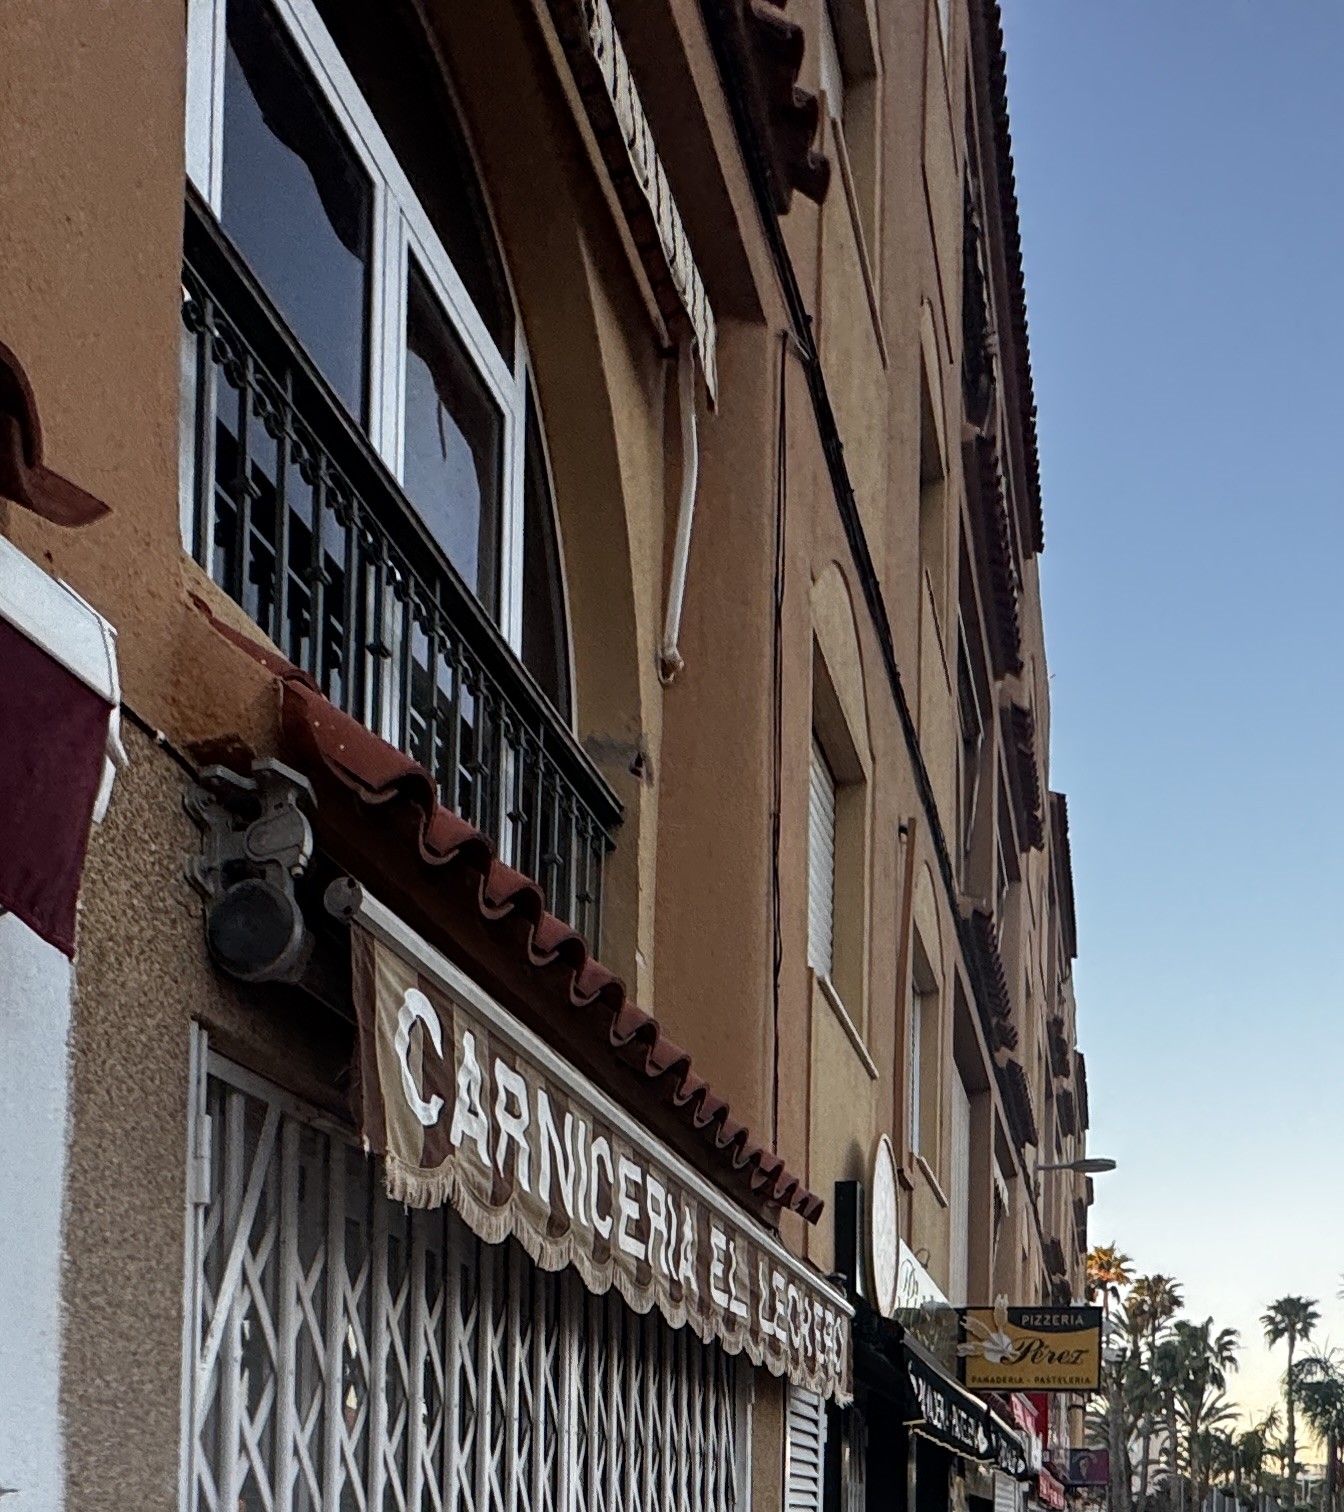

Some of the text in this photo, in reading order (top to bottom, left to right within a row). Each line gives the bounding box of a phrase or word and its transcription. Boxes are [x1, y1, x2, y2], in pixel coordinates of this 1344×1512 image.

[394, 987, 699, 1297] CARNICERIA
[710, 1224, 749, 1318] EL
[758, 1261, 844, 1373] LECHERO
[1021, 1314, 1085, 1326] PIZZERIA
[1034, 1375, 1091, 1384] PASTELERIA
